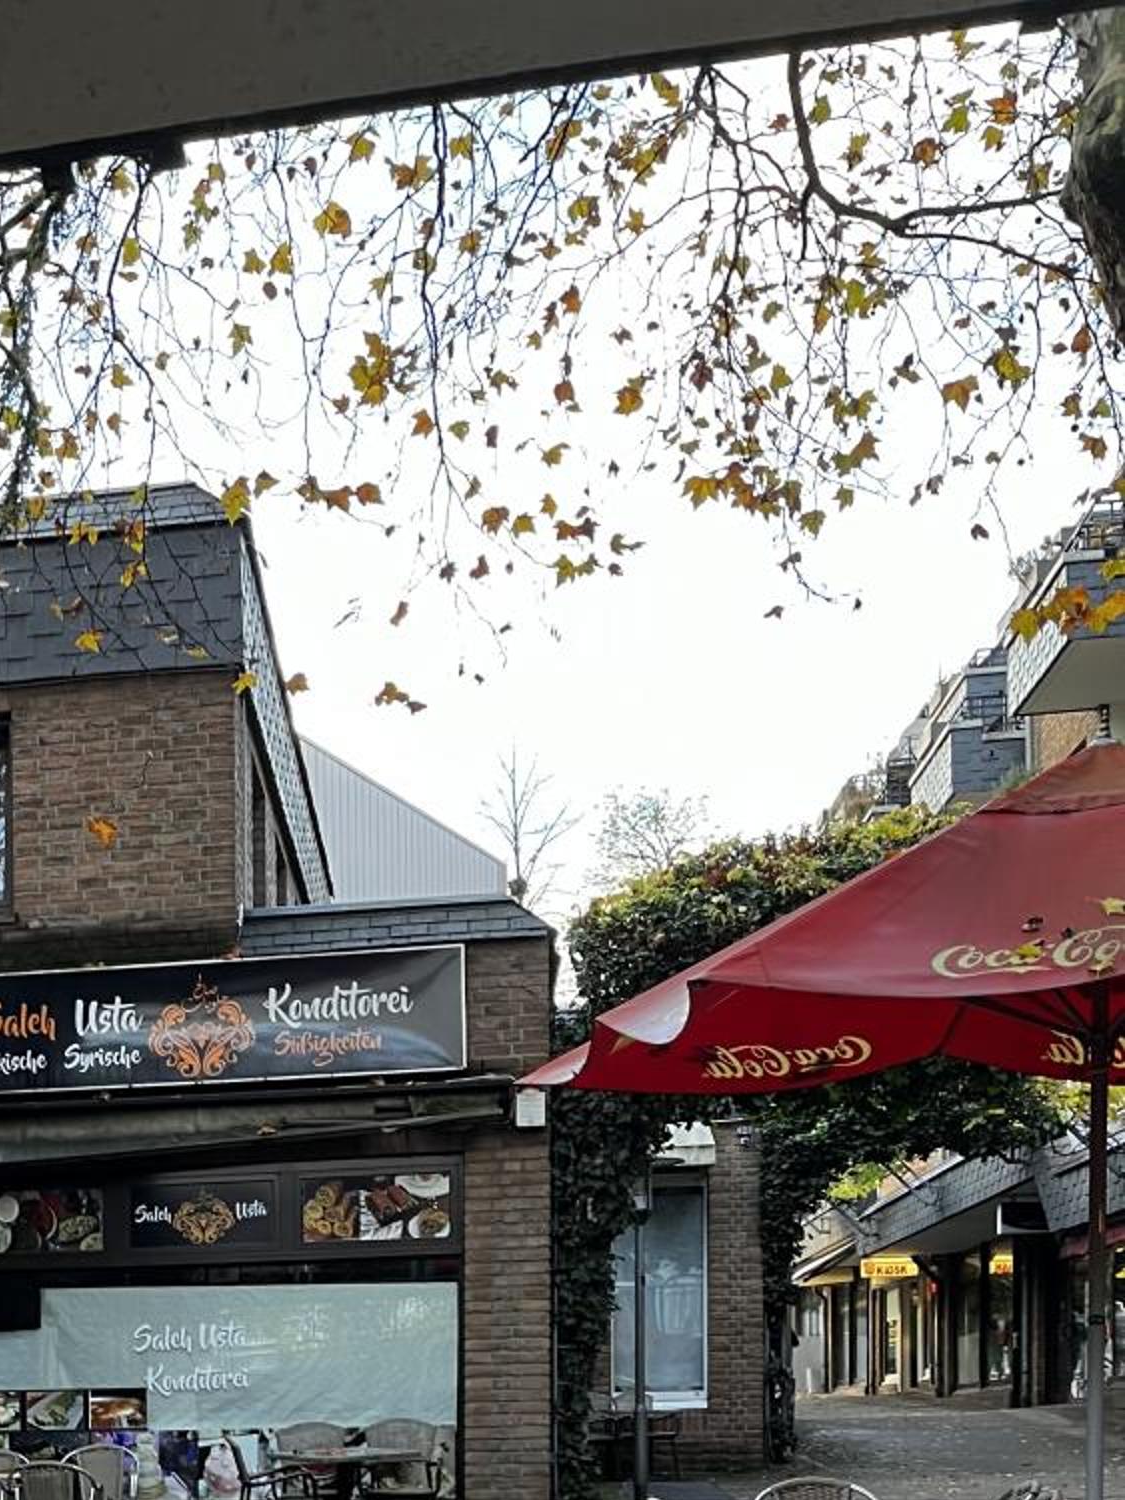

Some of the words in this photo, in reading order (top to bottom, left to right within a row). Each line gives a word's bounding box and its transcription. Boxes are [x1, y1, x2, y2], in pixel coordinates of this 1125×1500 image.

[75, 995, 144, 1037] Usta
[263, 980, 414, 1029] Konditorei
[64, 1043, 143, 1073] Syrische
[135, 1204, 172, 1224] Saleh
[236, 1199, 267, 1221] Usta
[134, 1324, 192, 1353] Saleh
[199, 1320, 246, 1350] Usta
[143, 1363, 251, 1397] Konditorei
